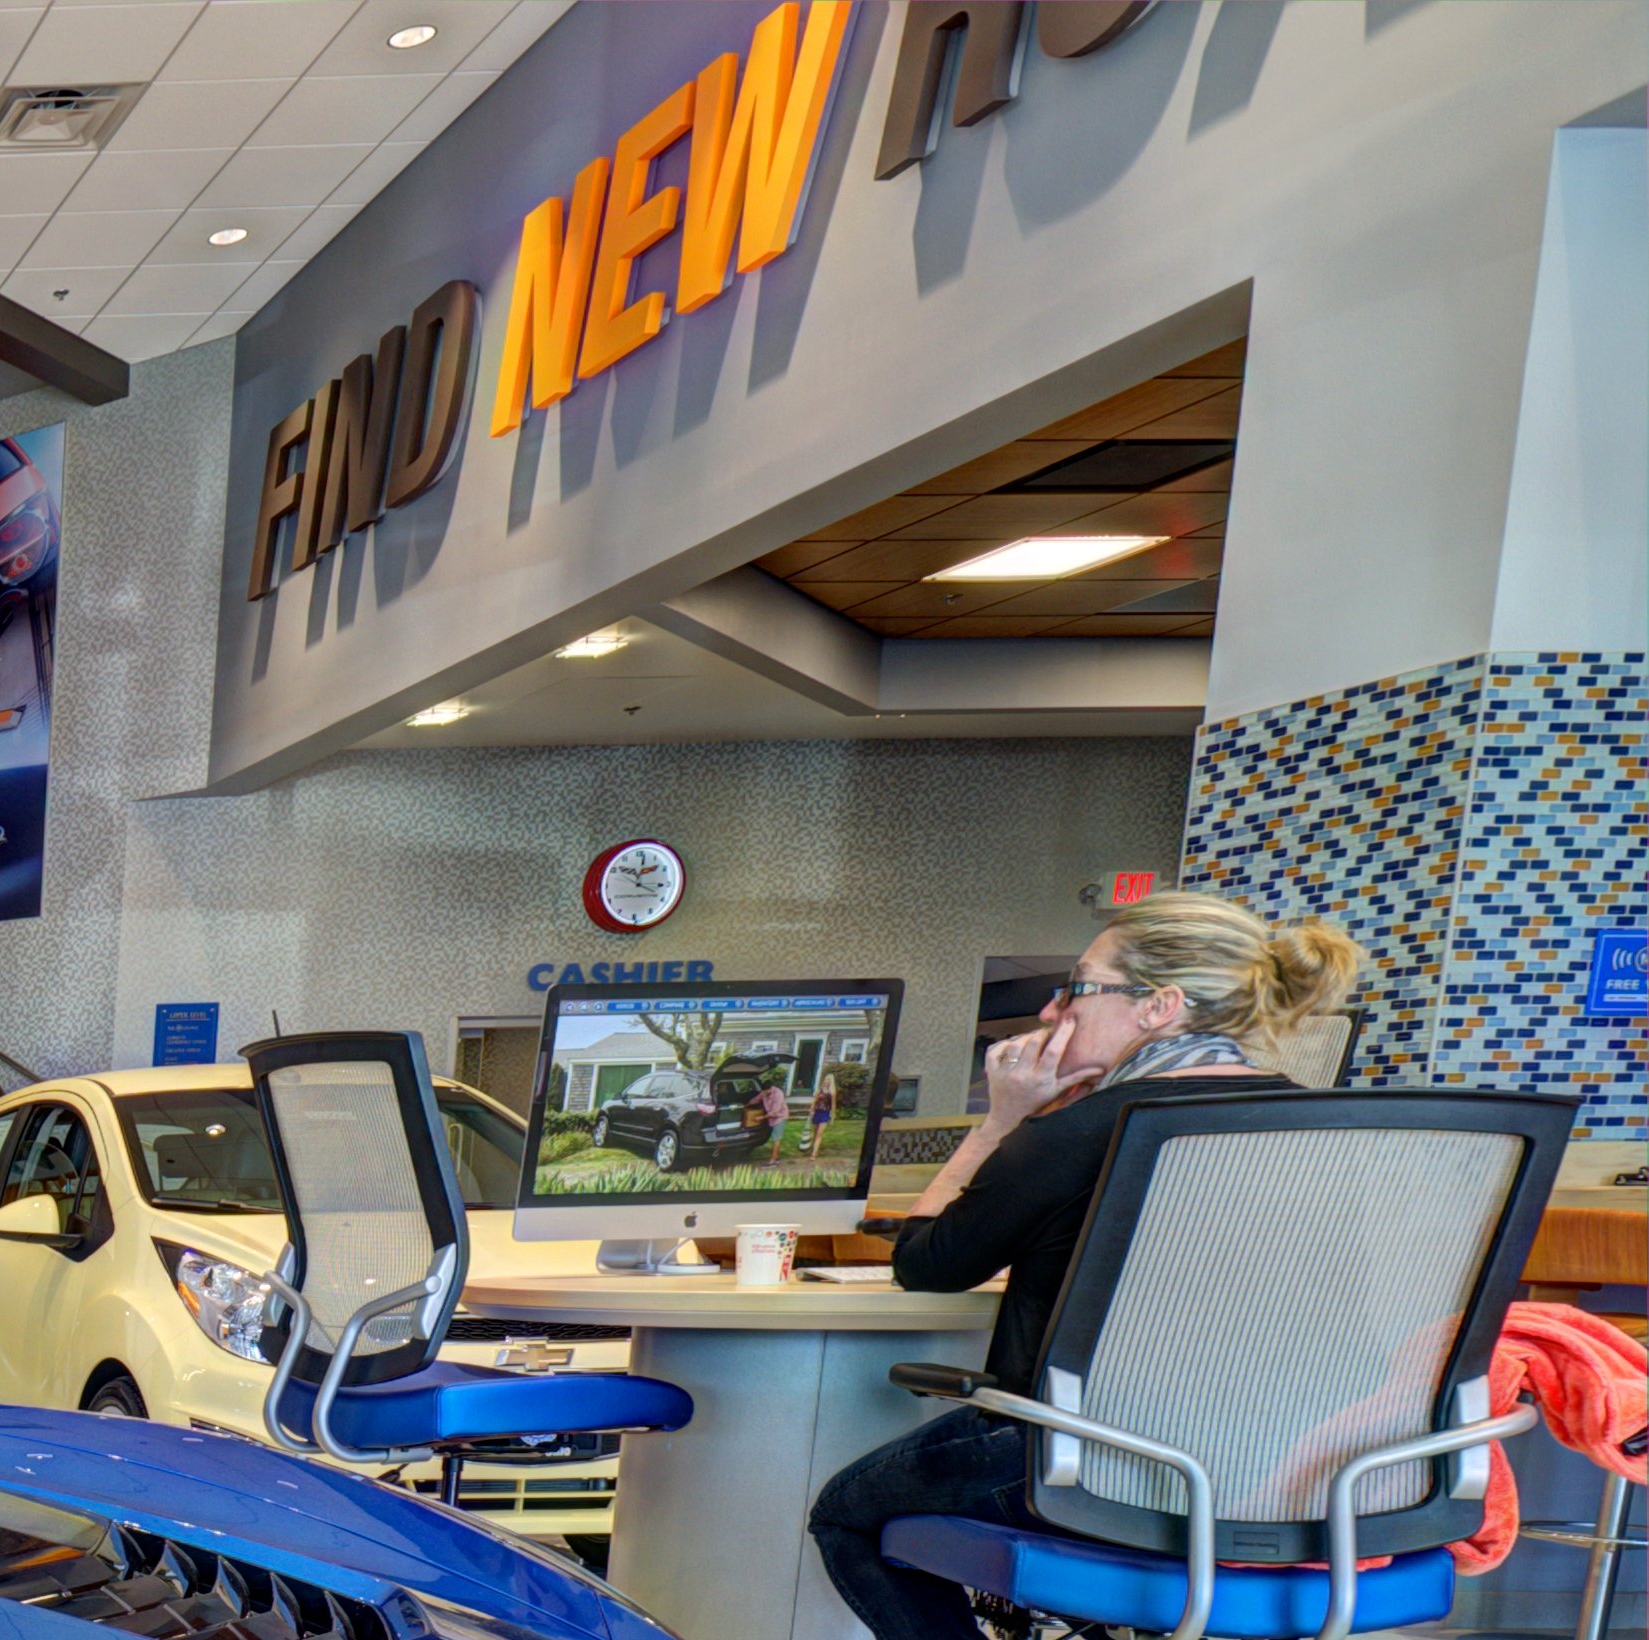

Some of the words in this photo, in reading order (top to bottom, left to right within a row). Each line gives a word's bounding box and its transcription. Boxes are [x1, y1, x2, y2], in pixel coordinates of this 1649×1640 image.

[248, 279, 482, 601] FIND
[490, 0, 854, 438] NEW
[1112, 872, 1155, 904] EXIT
[526, 960, 715, 992] CASHIER
[1605, 979, 1640, 990] FREE
